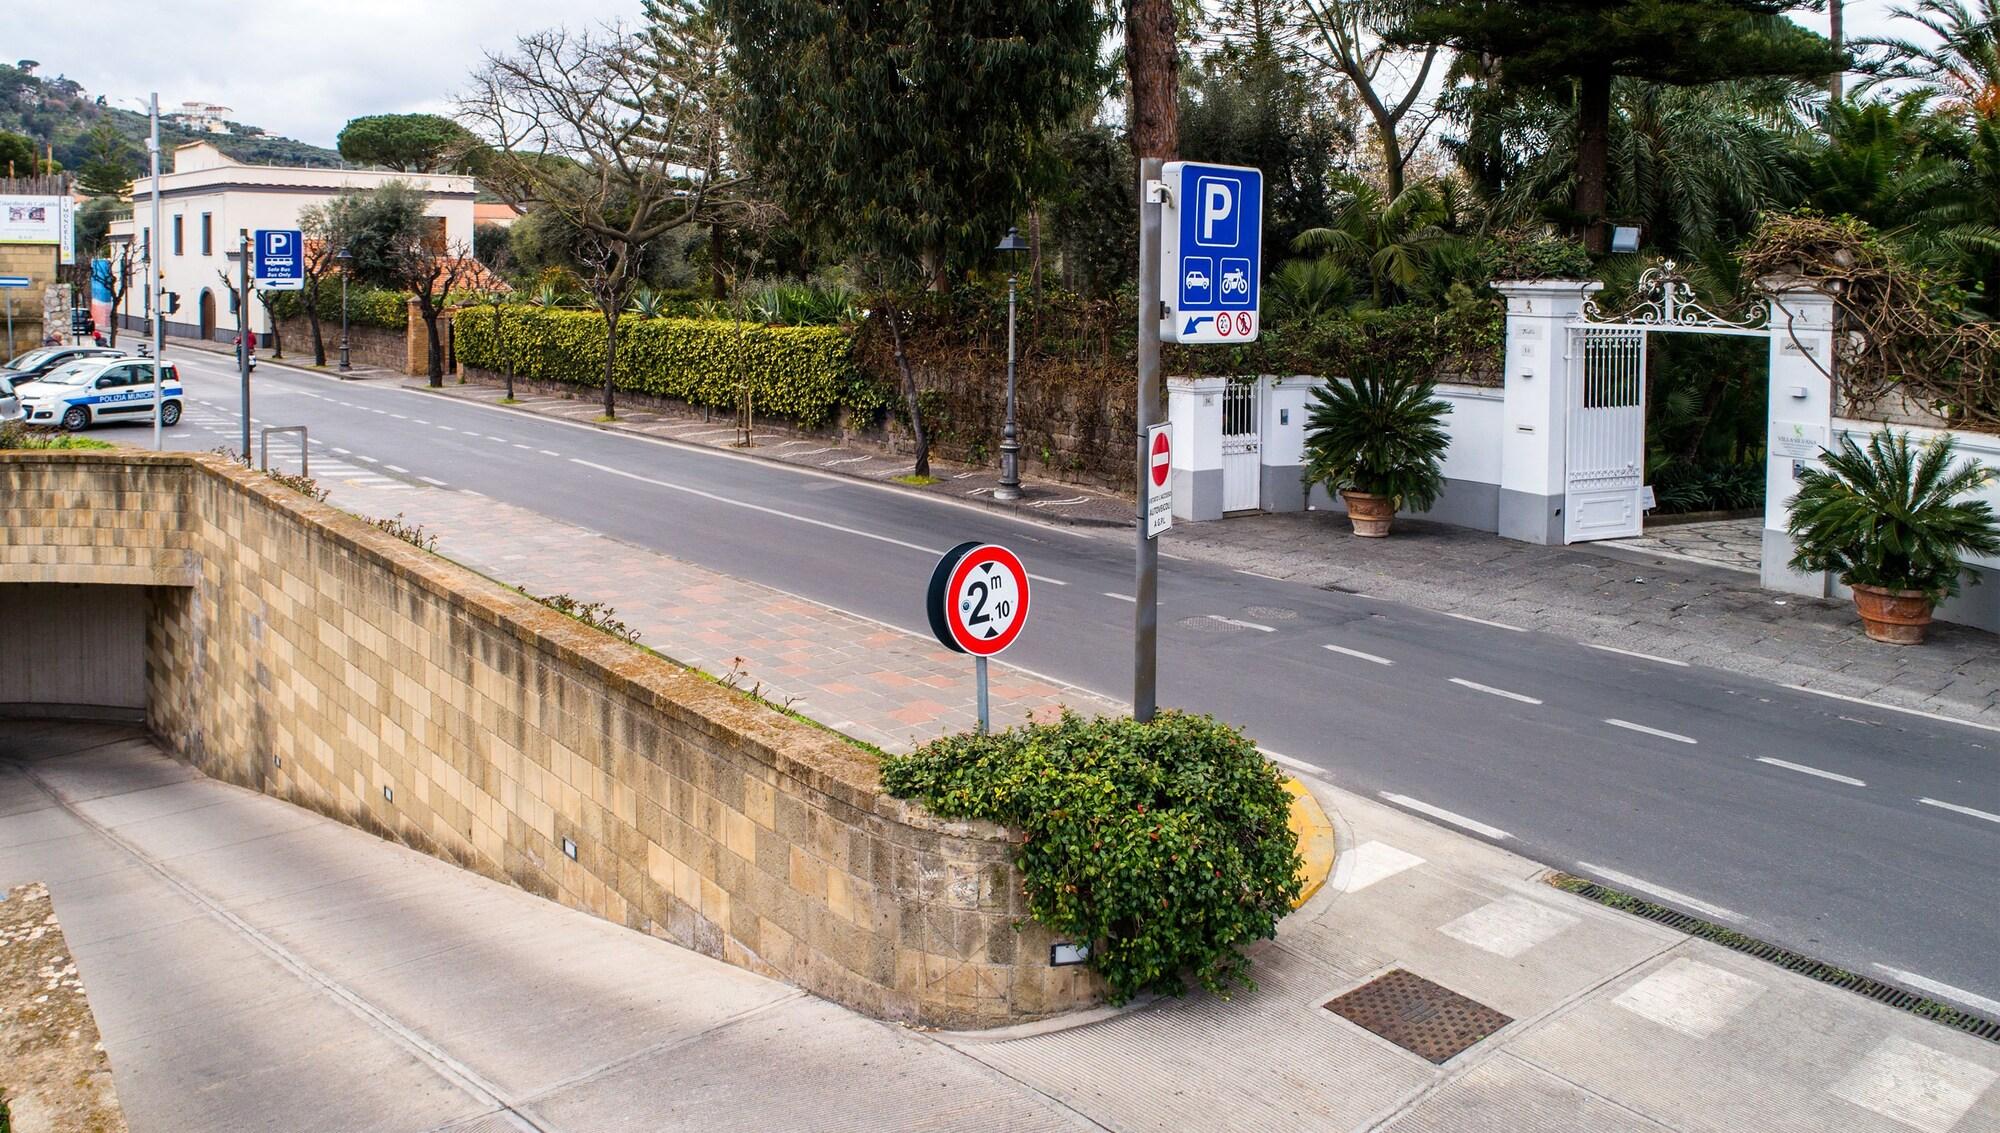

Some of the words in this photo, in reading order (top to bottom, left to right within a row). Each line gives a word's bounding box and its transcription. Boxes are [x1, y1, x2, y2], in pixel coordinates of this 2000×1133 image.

[1204, 183, 1232, 239] P
[270, 234, 288, 254] P
[100, 394, 126, 402] POLIZIA
[991, 575, 1002, 590] m
